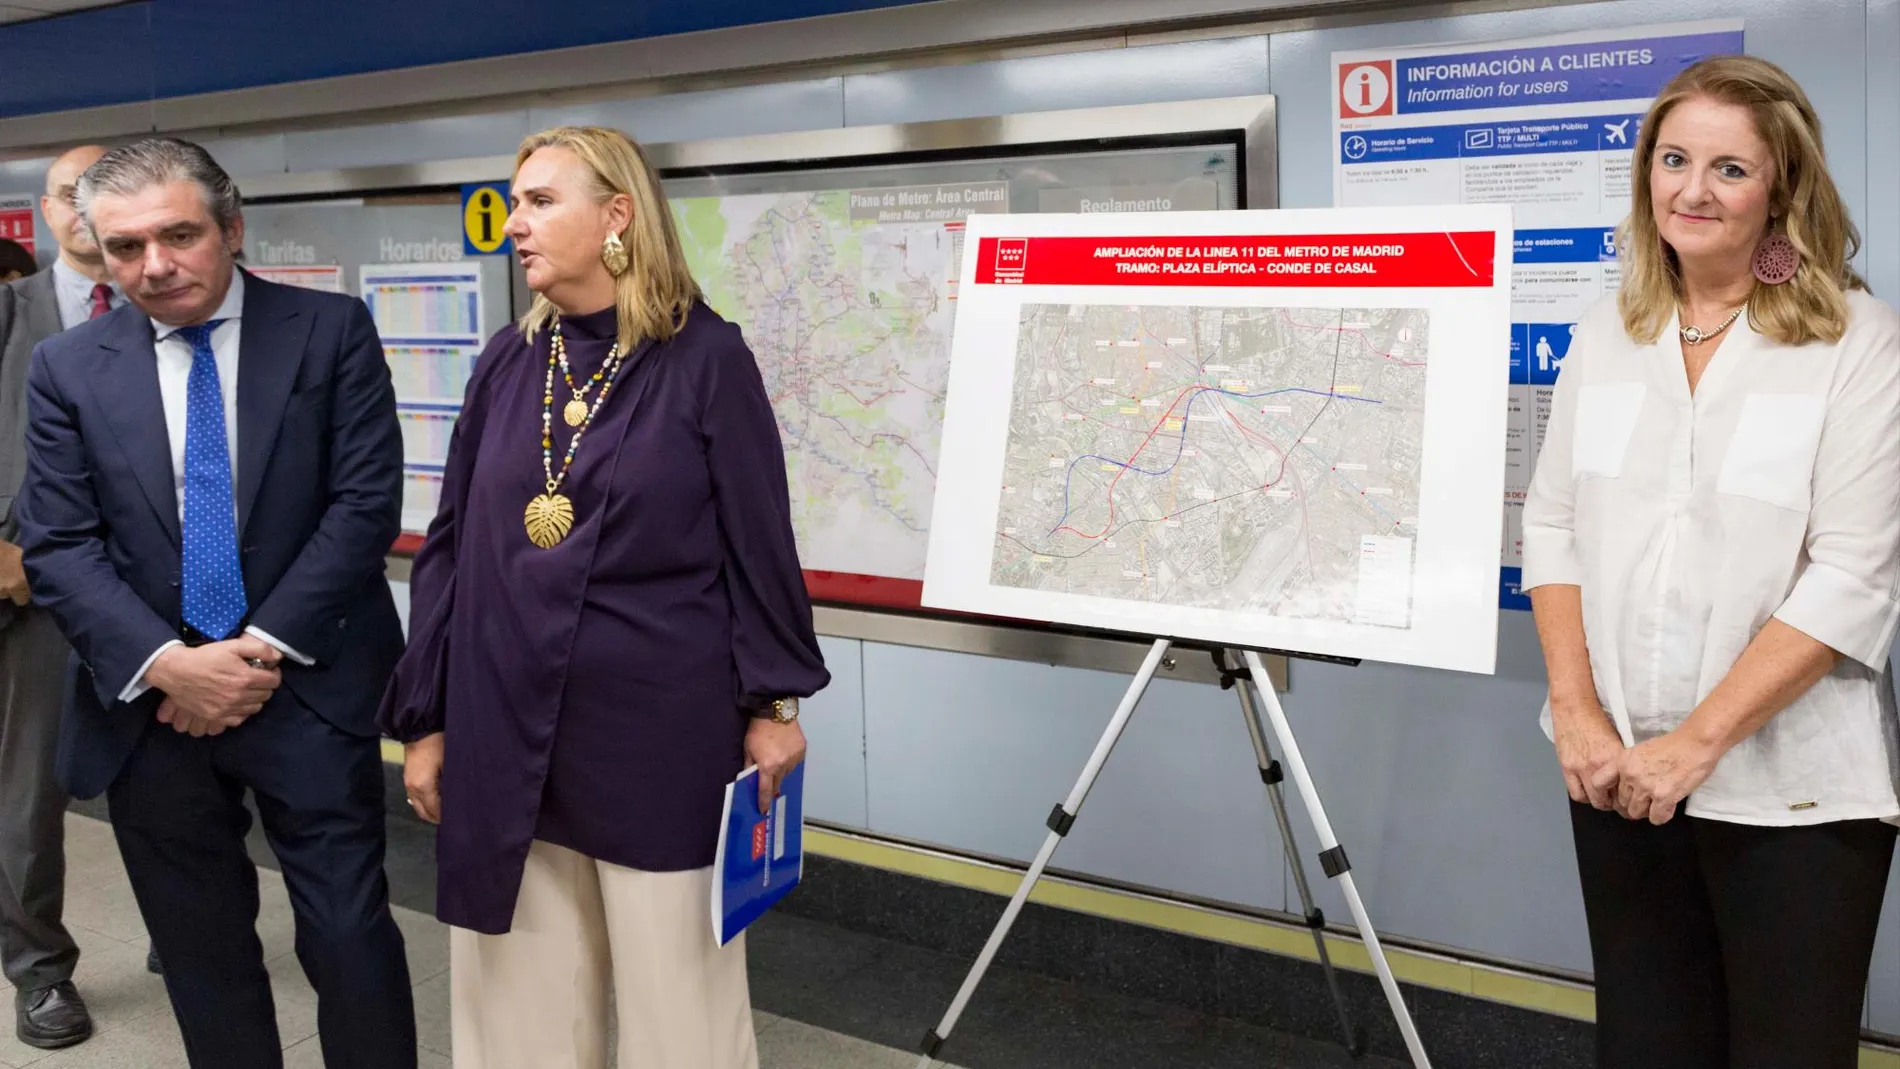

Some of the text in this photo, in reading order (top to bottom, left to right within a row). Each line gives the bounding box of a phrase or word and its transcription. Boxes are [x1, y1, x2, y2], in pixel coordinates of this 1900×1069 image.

[1407, 48, 1652, 82] INFORMACIÓN A CLIENTES
[1407, 79, 1569, 103] Information for users
[1497, 122, 1589, 135] Tarjeta Transporte Público
[1371, 136, 1434, 147] Horario de Servicio
[1517, 133, 1540, 141] MULTI
[850, 187, 1005, 208] Plano de Metro: Área Central
[1080, 197, 1172, 214] Reglamento
[878, 210, 901, 222] Metro
[903, 209, 923, 222] Map:
[925, 207, 953, 220] Central
[379, 237, 463, 263] Horarios
[1524, 239, 1534, 247] de
[1535, 238, 1574, 247] estaciones
[258, 240, 316, 264] Tarifas
[1094, 245, 1405, 258] AMPLIACIÓN DE LA LINEA 11 DEL METRO DE MADRID
[1115, 262, 1160, 274] TRAMO:
[1162, 262, 1201, 273] PLAZA
[1203, 259, 1256, 274] ELÍPTICA
[1267, 262, 1311, 274] CONDE
[1314, 262, 1332, 274] DE
[1335, 262, 1377, 274] CASAL
